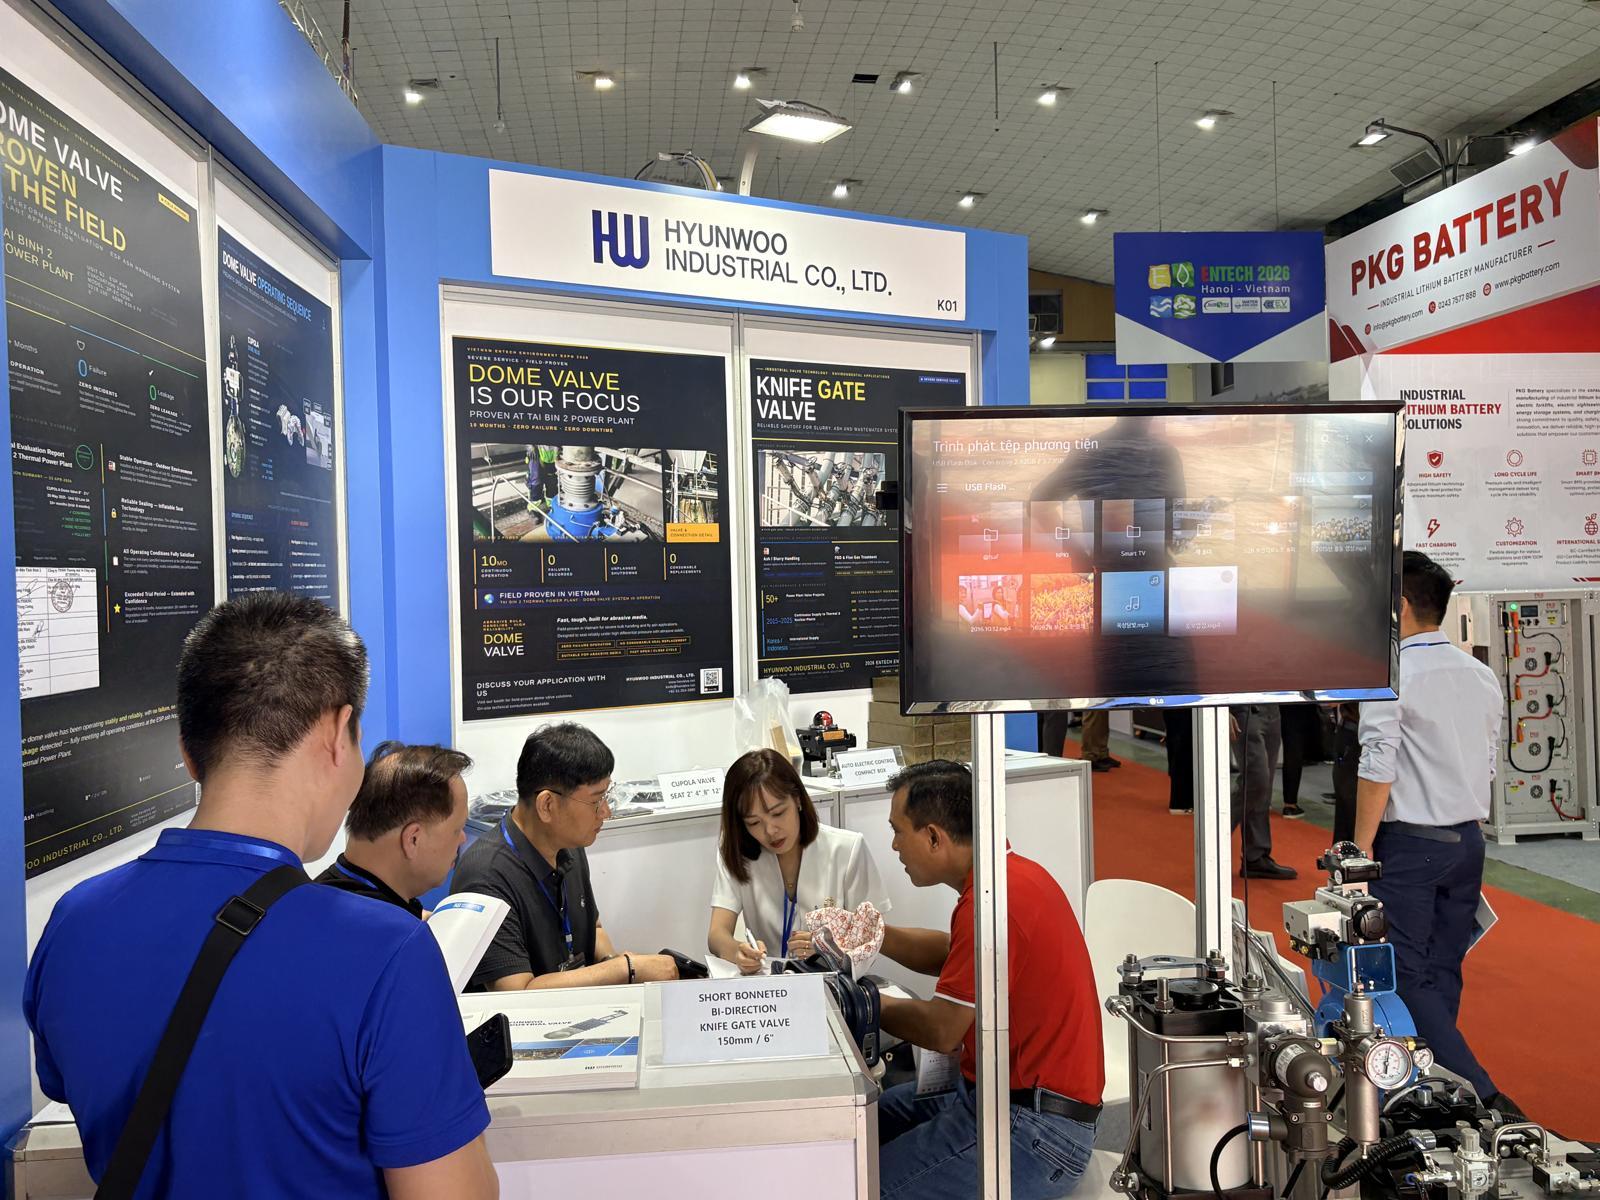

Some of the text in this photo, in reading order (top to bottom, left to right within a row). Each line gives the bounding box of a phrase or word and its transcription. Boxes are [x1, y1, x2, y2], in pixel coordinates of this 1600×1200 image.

[54, 136, 124, 201] VALVE
[4, 163, 126, 251] THE FIELD
[664, 218, 788, 256] HYUNWOO
[1351, 170, 1569, 296] PKG BATTERY
[18, 234, 53, 260] BINH 2
[5, 242, 75, 282] OWER PLANT
[665, 247, 892, 296] INDUSTRIAL CO., LTD.
[1201, 265, 1290, 282] ENTECH 2026
[1380, 245, 1533, 308] INDUSTRIAL LITHIUM BATTERY MANUFACTURER
[1494, 261, 1560, 290] www.pkgbattery.com
[222, 250, 240, 275] DOME
[239, 263, 257, 287] VALVE
[257, 276, 287, 305] OPERATING
[286, 296, 312, 322] SEQUENCE
[1201, 284, 1290, 294] Hanoi Vietnam
[937, 300, 958, 312] K01
[13, 340, 38, 354] Months
[10, 361, 44, 376] OPERATION
[89, 364, 107, 376] Failure
[469, 363, 620, 391] DOME VALVE
[79, 380, 118, 399] ZERO INCIDENTS
[757, 375, 866, 401] KNIFE GATE
[158, 390, 175, 402] Leakage
[470, 386, 640, 413] IS OUR FOCUS
[1400, 389, 1466, 401] INDUSTRIAL
[161, 407, 179, 418] LEAKAGE
[757, 399, 816, 421] VALVE
[1407, 403, 1502, 415] ITHIUM BATTERY
[469, 410, 635, 425] PROVEN AT TAI BIN 2 POWER PLANT
[1404, 418, 1462, 430] OLUTIONS
[17, 442, 65, 458] Evaluation Report
[933, 438, 1099, 455] Trình phát tệp phương tiện
[18, 452, 73, 469] Thermal Power Plant
[120, 454, 170, 471] Stable Operation Outdoor
[965, 482, 1007, 492] USB Flash
[121, 498, 138, 506] Reliable
[121, 505, 144, 514] Technology
[547, 554, 556, 566] 0
[610, 553, 619, 564] 0
[669, 553, 677, 564] 0
[524, 591, 555, 599] PROVEN
[765, 594, 778, 604] 50+
[484, 632, 524, 645] DOME
[484, 645, 525, 657] VALVE
[794, 664, 826, 672] INDUSTRIAL
[476, 681, 511, 689] DISCUSS
[514, 679, 535, 687] YOUR
[537, 677, 585, 685] APPLICATION
[27, 714, 128, 743] dome valve has been operating and
[40, 726, 126, 752] detected fully meeting operating
[40, 754, 57, 763] Power
[841, 757, 896, 769] AUTO ELECTRIC CONTROL
[855, 769, 876, 777] COMPACT
[671, 776, 716, 788] CUPOLA VALVE
[670, 787, 722, 800] SEAT 2" 12"
[24, 812, 35, 822] Ash
[43, 838, 91, 864] INDUSTRIAL
[698, 989, 788, 1003] SHORT BONNETED
[711, 1004, 777, 1017] BI-DIRECTION
[700, 1018, 791, 1032] KNIFE GATE VALVE
[718, 1033, 774, 1046] 150mm / 6"
